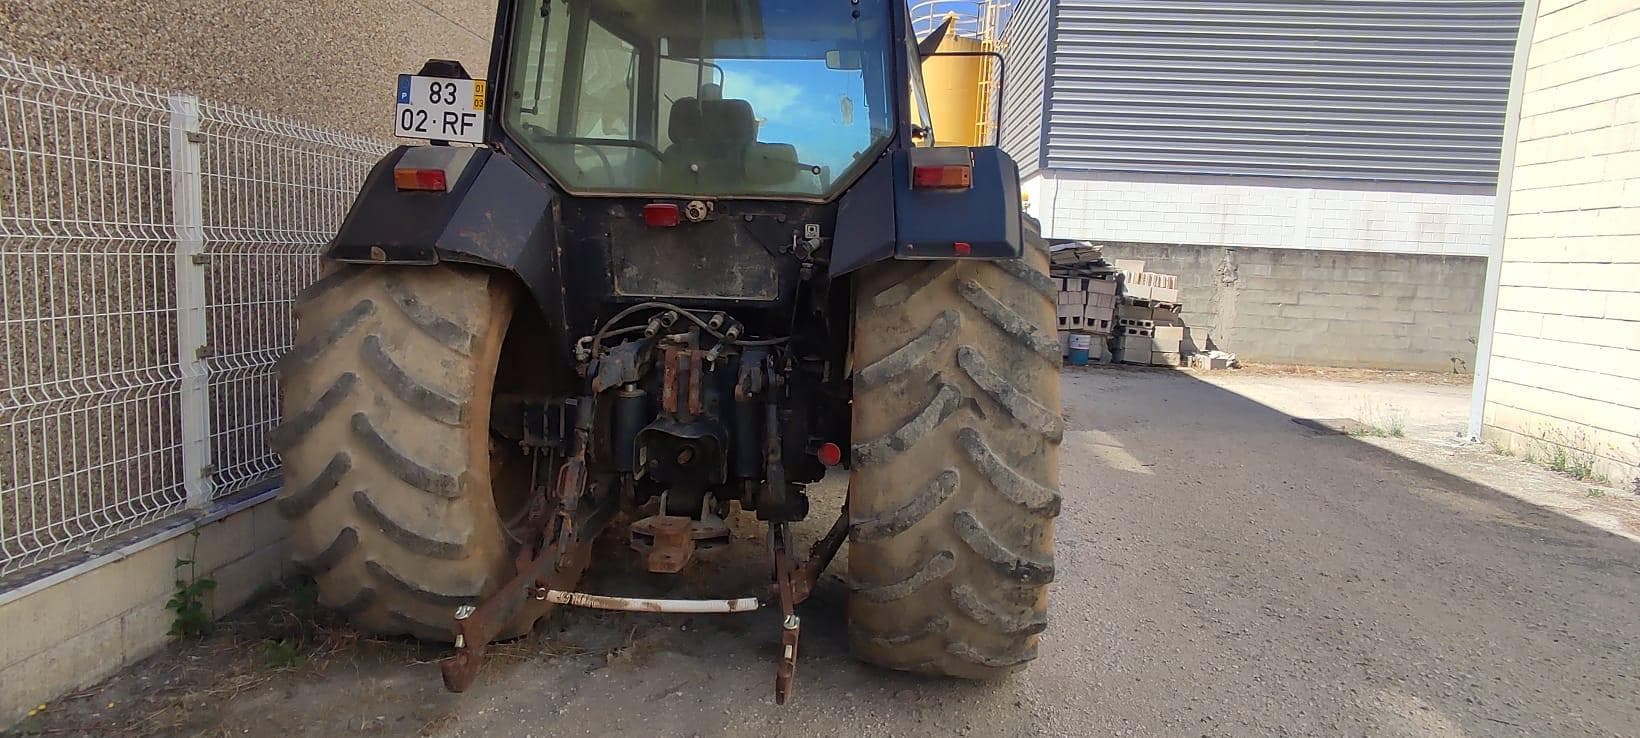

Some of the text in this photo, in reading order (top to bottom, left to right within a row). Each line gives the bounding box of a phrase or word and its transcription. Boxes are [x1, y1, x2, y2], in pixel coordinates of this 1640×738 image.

[475, 84, 484, 92] 01
[429, 81, 457, 105] 83
[474, 99, 484, 107] 03
